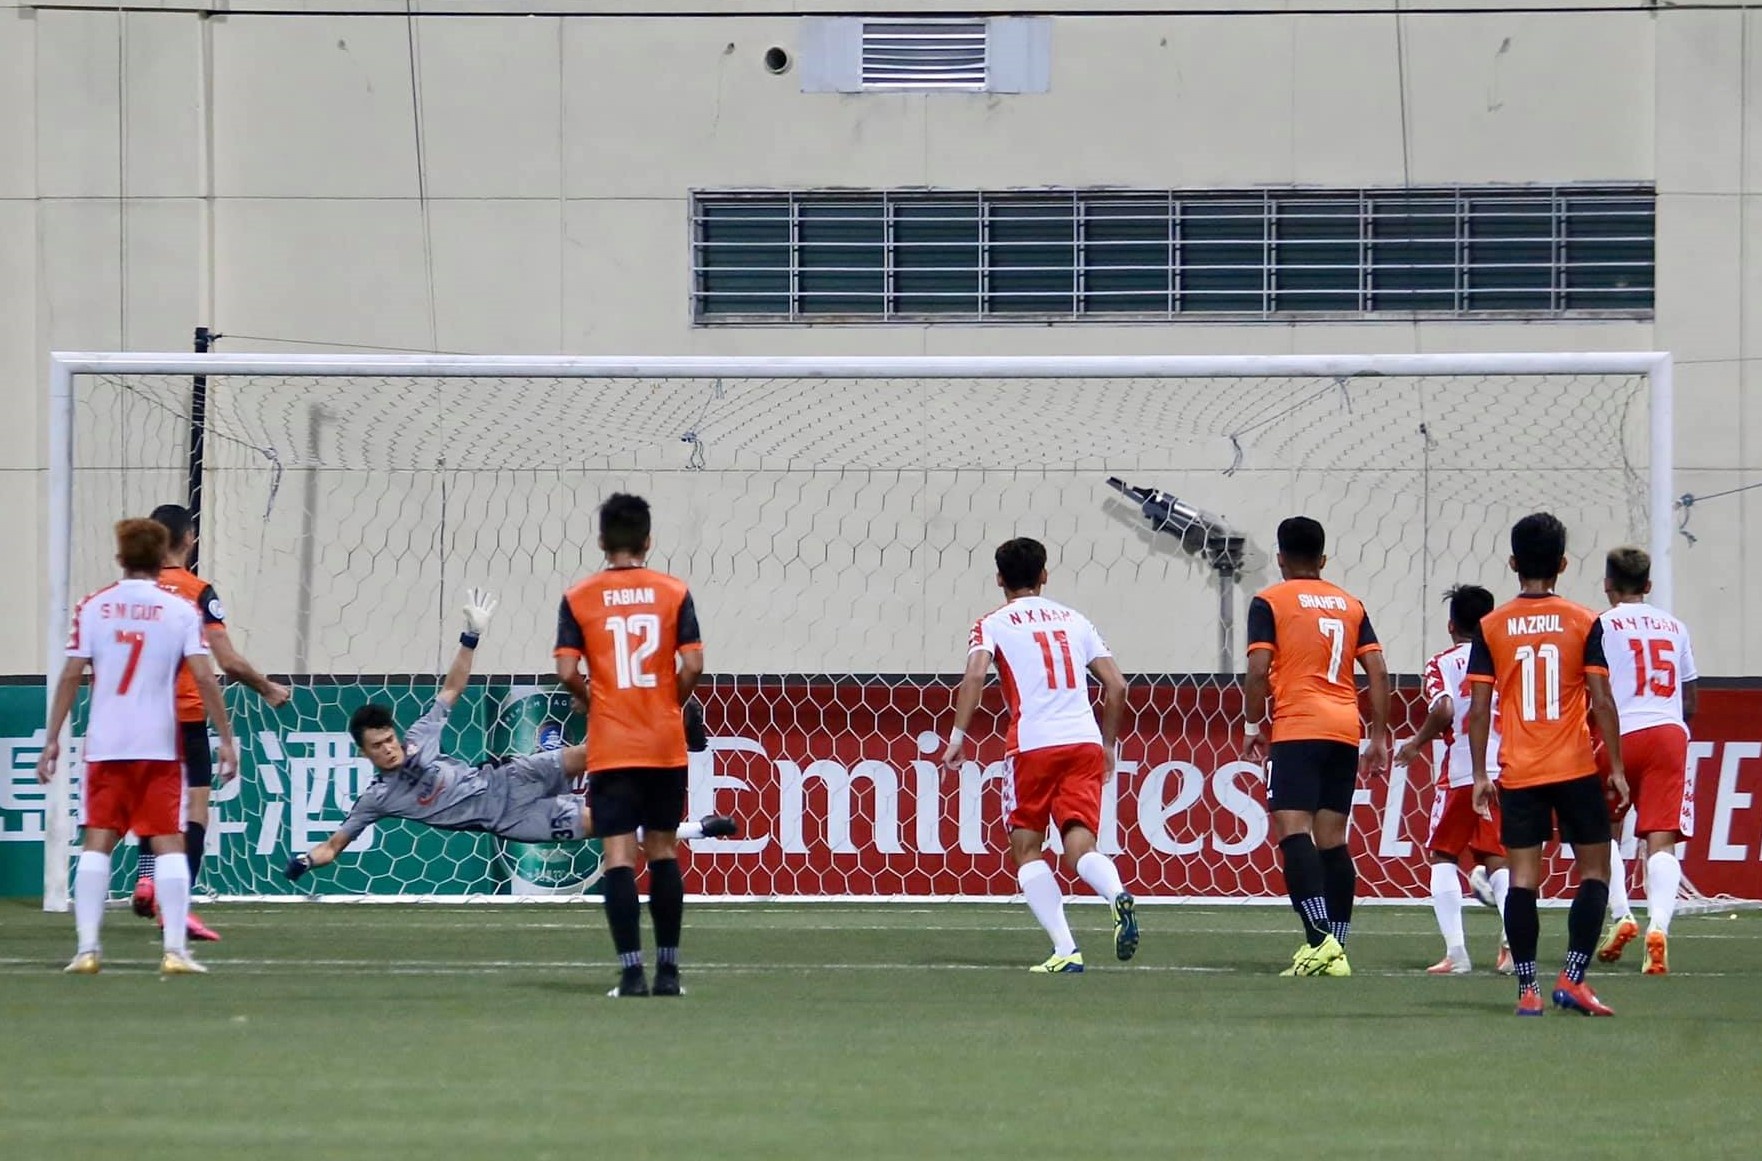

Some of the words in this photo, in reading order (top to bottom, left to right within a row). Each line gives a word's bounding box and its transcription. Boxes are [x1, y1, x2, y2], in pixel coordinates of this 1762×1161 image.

[602, 587, 655, 607] FABIAN
[1507, 615, 1564, 636] NAZRUL
[115, 630, 145, 695] 7
[604, 613, 660, 690] 12
[1033, 629, 1076, 690] 11
[1318, 617, 1344, 684] 7
[1514, 643, 1560, 721] 11
[1628, 638, 1676, 698] 15
[687, 731, 1268, 855] Emirtes
